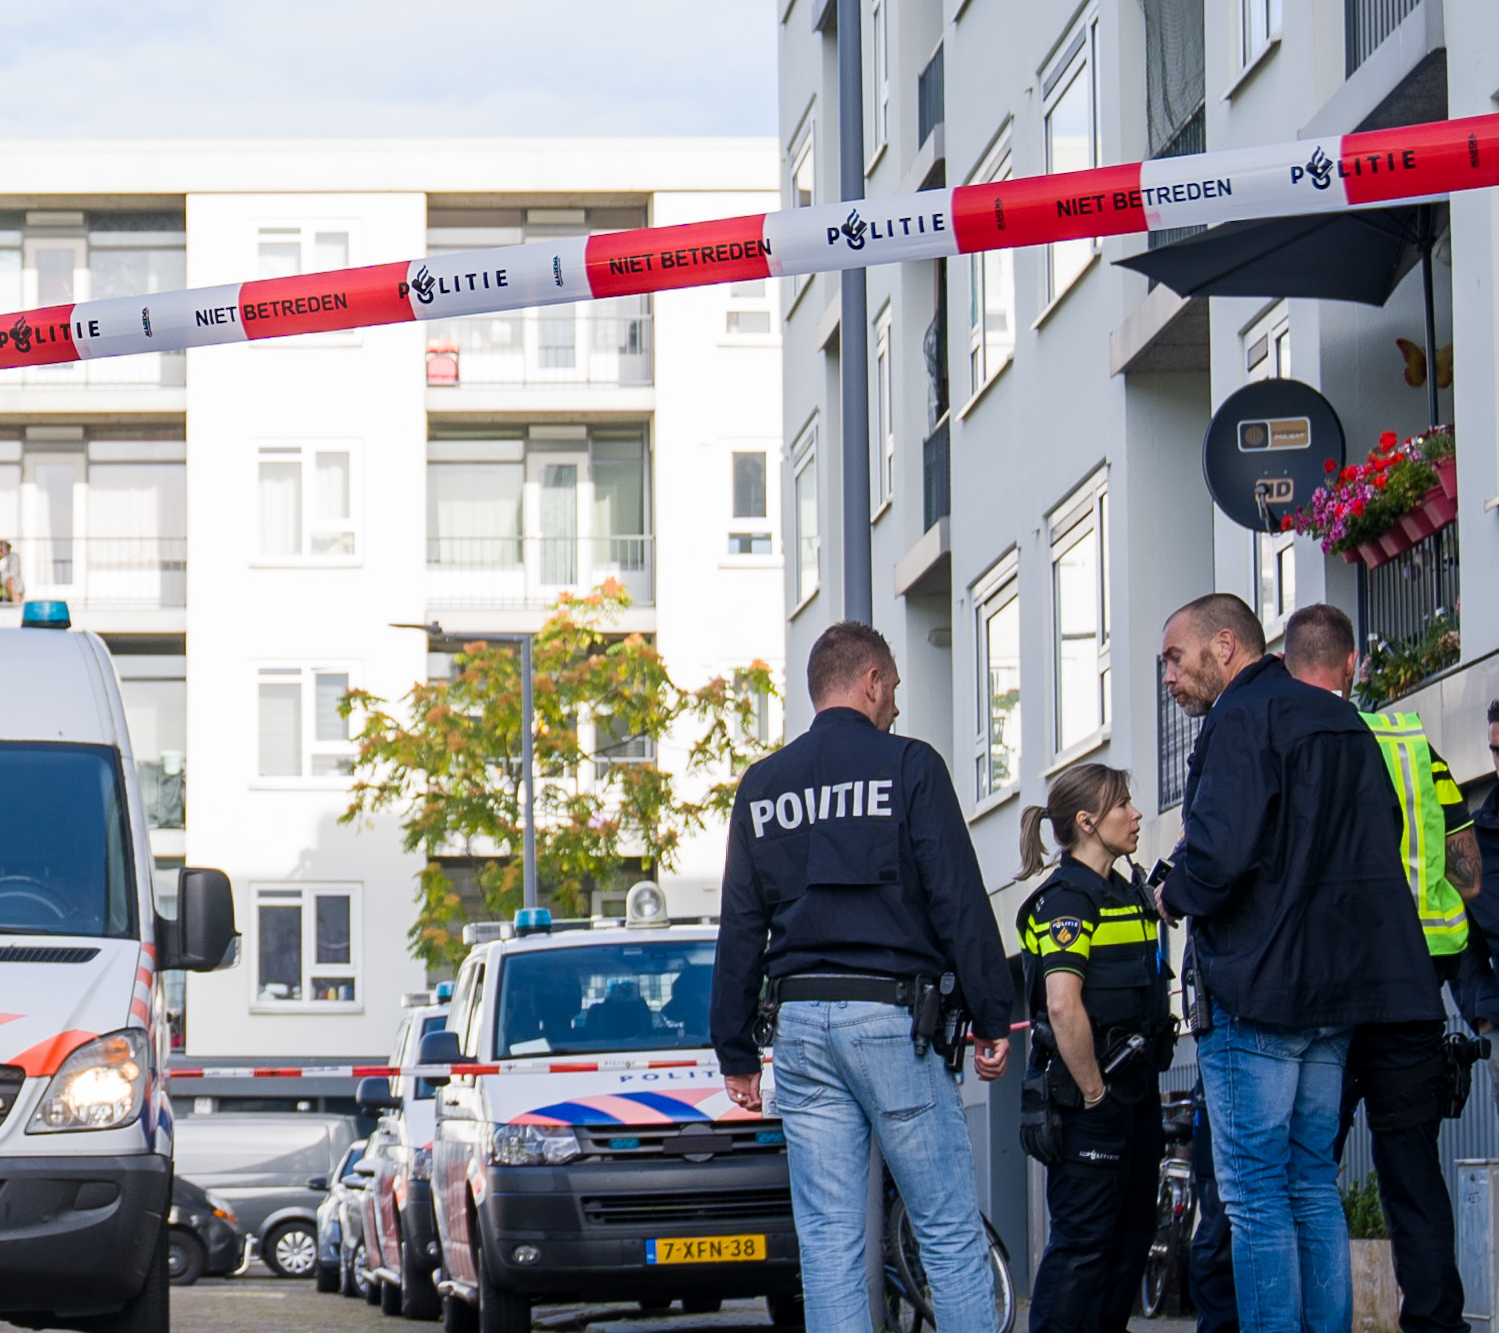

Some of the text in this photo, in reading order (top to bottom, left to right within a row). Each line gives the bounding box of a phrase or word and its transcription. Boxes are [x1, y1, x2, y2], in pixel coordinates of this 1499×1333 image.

[1290, 145, 1417, 191] POLITIE
[1056, 178, 1233, 218] NIET BETREDEN
[826, 208, 946, 251] POLITIE
[608, 238, 772, 277] NIET BETREDEN
[398, 264, 509, 305] POLITIE
[195, 292, 349, 327] NIET BETREDEN
[749, 779, 893, 839] POLITIE
[663, 1239, 756, 1260] 7-XFN-38
